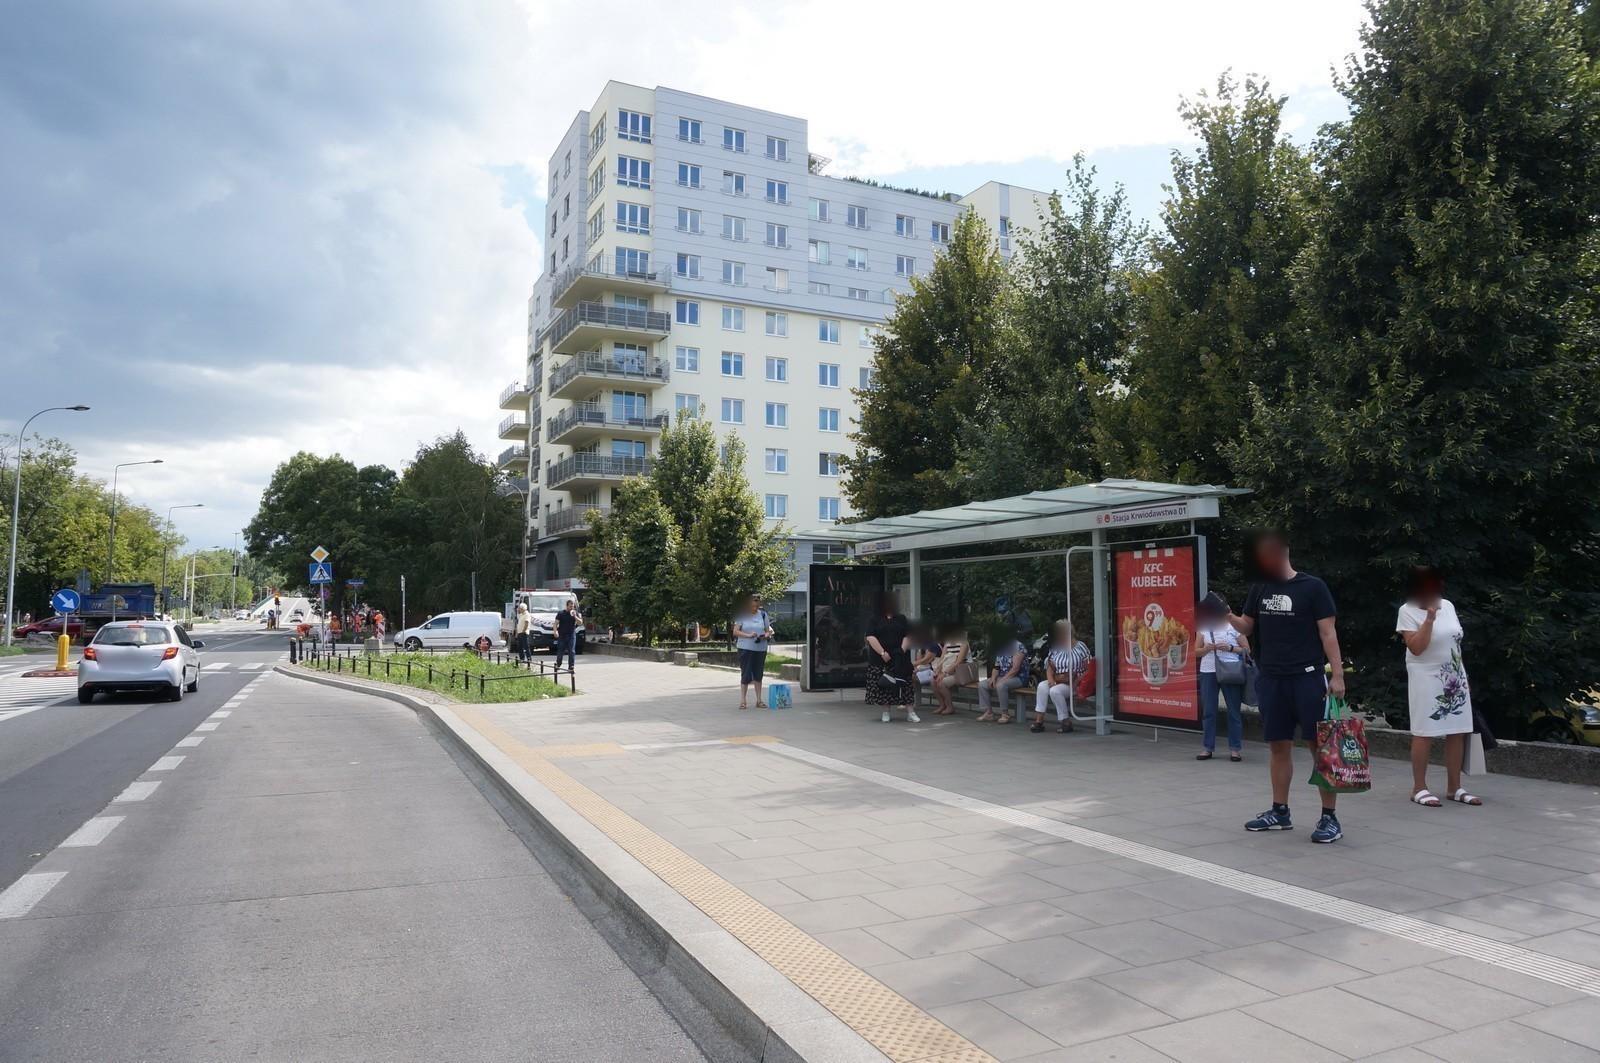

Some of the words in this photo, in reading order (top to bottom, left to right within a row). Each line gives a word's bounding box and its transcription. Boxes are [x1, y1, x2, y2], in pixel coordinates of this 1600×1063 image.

[1112, 513, 1129, 523] Stacja
[1130, 509, 1177, 520] Krwiodawstwa
[1178, 507, 1186, 515] 01
[1143, 563, 1164, 574] KFC
[1131, 575, 1177, 588] KUBEŁEK
[1262, 598, 1282, 606] NORTH
